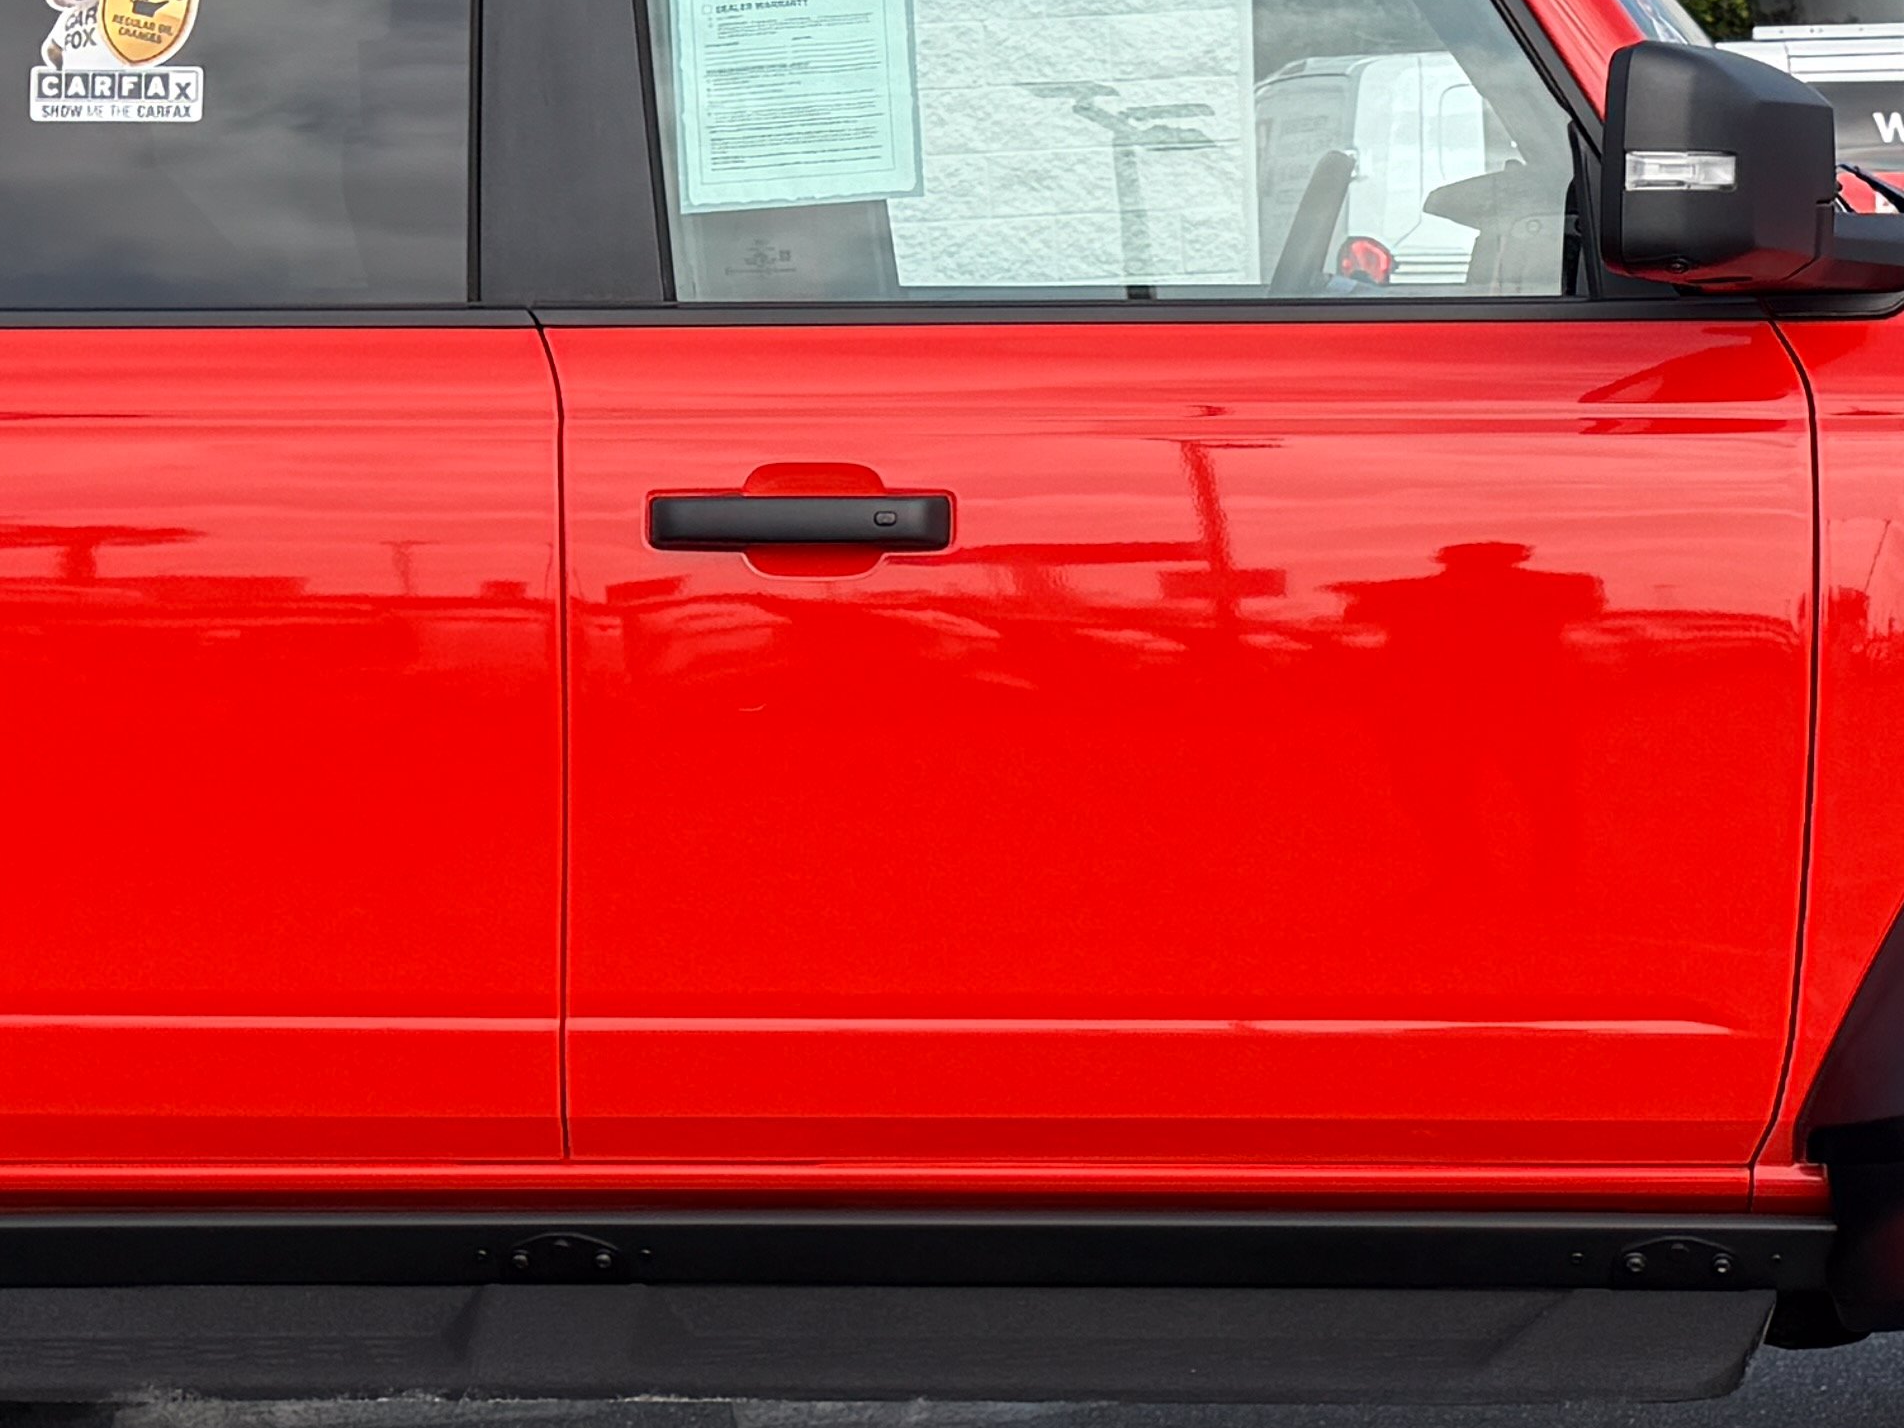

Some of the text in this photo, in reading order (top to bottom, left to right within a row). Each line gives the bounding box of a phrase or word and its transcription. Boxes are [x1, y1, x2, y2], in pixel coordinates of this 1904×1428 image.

[65, 6, 97, 32] CAR
[64, 27, 97, 51] FOX
[39, 74, 193, 100] CARFAX
[41, 104, 83, 118] SHOW
[136, 104, 192, 118] CARFAX
